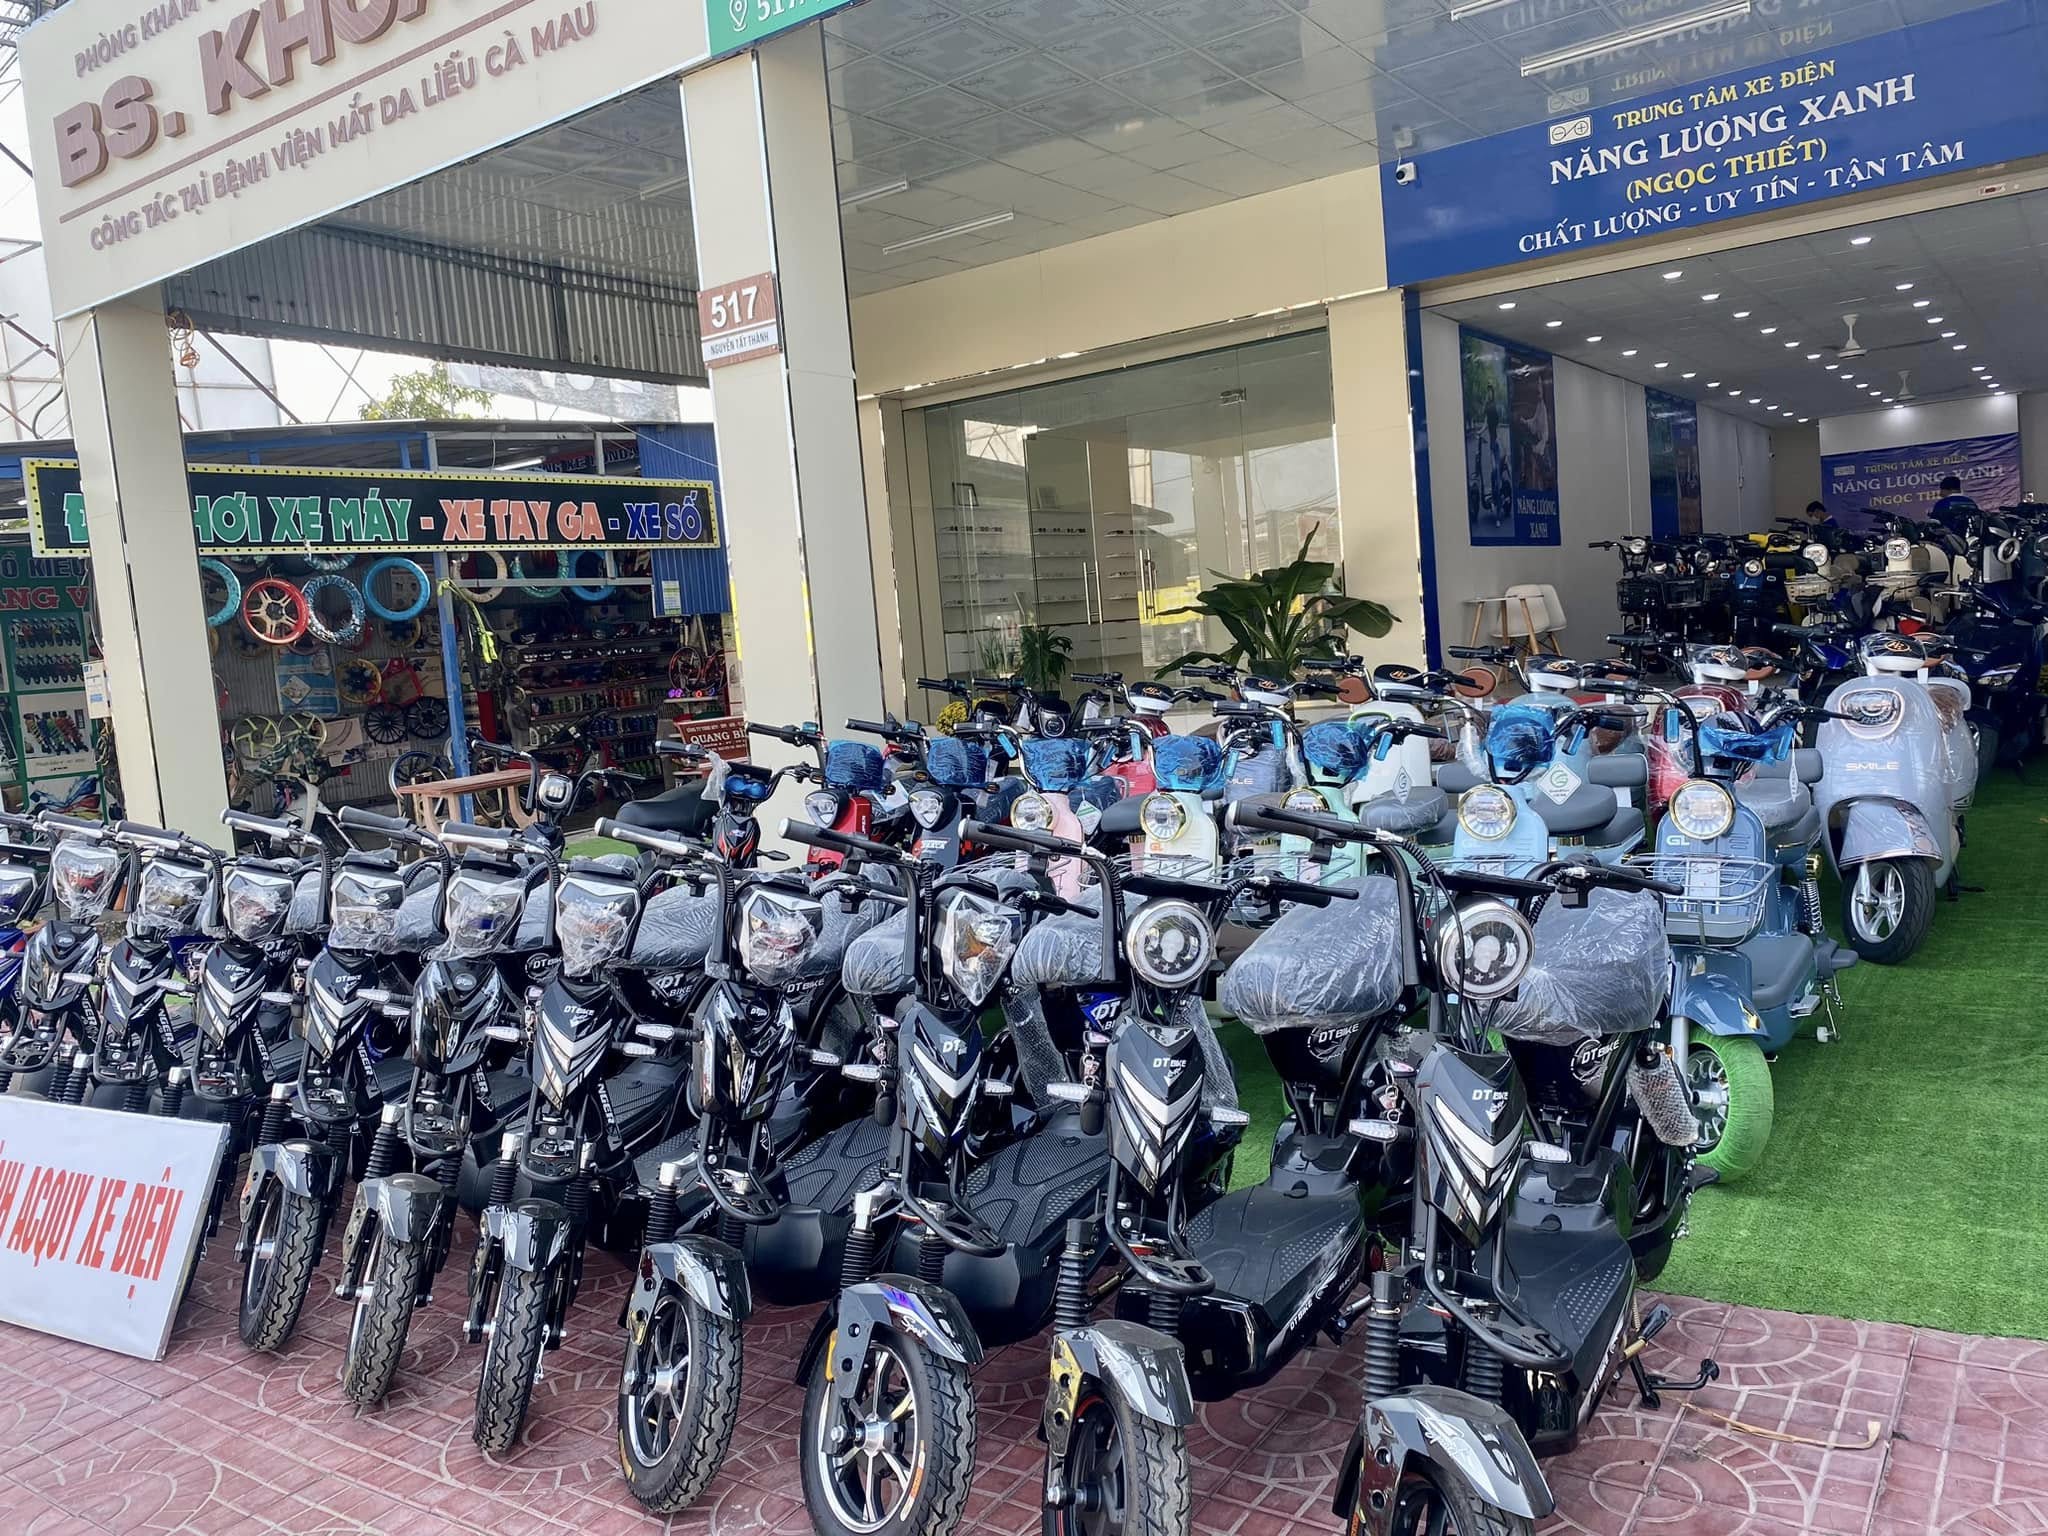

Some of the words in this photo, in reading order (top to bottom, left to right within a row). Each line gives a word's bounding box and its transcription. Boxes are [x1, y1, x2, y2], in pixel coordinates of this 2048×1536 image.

[74, 23, 138, 78] PHÒNG
[1612, 99, 1685, 130] TRUNG
[1689, 86, 1739, 111] TÂM
[1743, 76, 1775, 98] XE
[1779, 59, 1837, 88] ĐIỆN
[53, 75, 185, 187] BS.
[90, 210, 140, 250] CÔNG
[141, 191, 178, 228] TÁC
[178, 170, 210, 215] TẠI
[212, 152, 270, 198] BỆNH
[271, 127, 325, 171] VIỆN
[379, 87, 417, 126] DA
[421, 50, 477, 107] LIỄU
[484, 30, 526, 78] CÀ
[530, 1, 597, 57] MAU
[1550, 139, 1649, 185] NĂNG
[1659, 104, 1788, 160] LƯỢNG
[1798, 73, 1916, 127] XANH
[1625, 163, 1717, 204] (NGỌC
[1723, 134, 1828, 178] THIẾT)
[1518, 217, 1586, 254] CHẤT
[1593, 203, 1681, 236] LƯỢNG
[1704, 189, 1742, 214] UY
[1750, 175, 1799, 203] TÍN
[1824, 157, 1887, 189] TẬN
[1895, 140, 1965, 173] TÂM
[711, 285, 758, 329] 517
[1864, 462, 1898, 473] TRUNG
[1832, 478, 1880, 494] NĂNG
[1886, 471, 1946, 489] LƯỢNG
[267, 496, 324, 543] XE
[328, 487, 412, 542] MÁY
[439, 498, 486, 542] XE
[490, 499, 551, 541] TAY
[556, 501, 606, 541] GA
[624, 502, 662, 540] XE
[665, 490, 702, 540] SỐ
[690, 730, 730, 745] QUANG
[1845, 760, 1900, 772] SMILE
[1666, 834, 1690, 846] GL
[264, 938, 285, 951] DT
[660, 973, 685, 988] DT
[669, 984, 693, 997] BIKE
[787, 982, 803, 993] DT
[1094, 1000, 1121, 1020] DT
[1318, 1029, 1337, 1043] DT
[1335, 1023, 1360, 1039] BIKE
[1152, 1057, 1170, 1068] DT
[1170, 1059, 1187, 1068] BIKE
[1581, 1049, 1599, 1065] DT
[1472, 1089, 1494, 1101] DT
[1493, 1091, 1509, 1101] BIKE
[6, 1165, 95, 1268] ACQUY
[75, 1176, 127, 1268] XE
[110, 1166, 184, 1299] ĐIỆN
